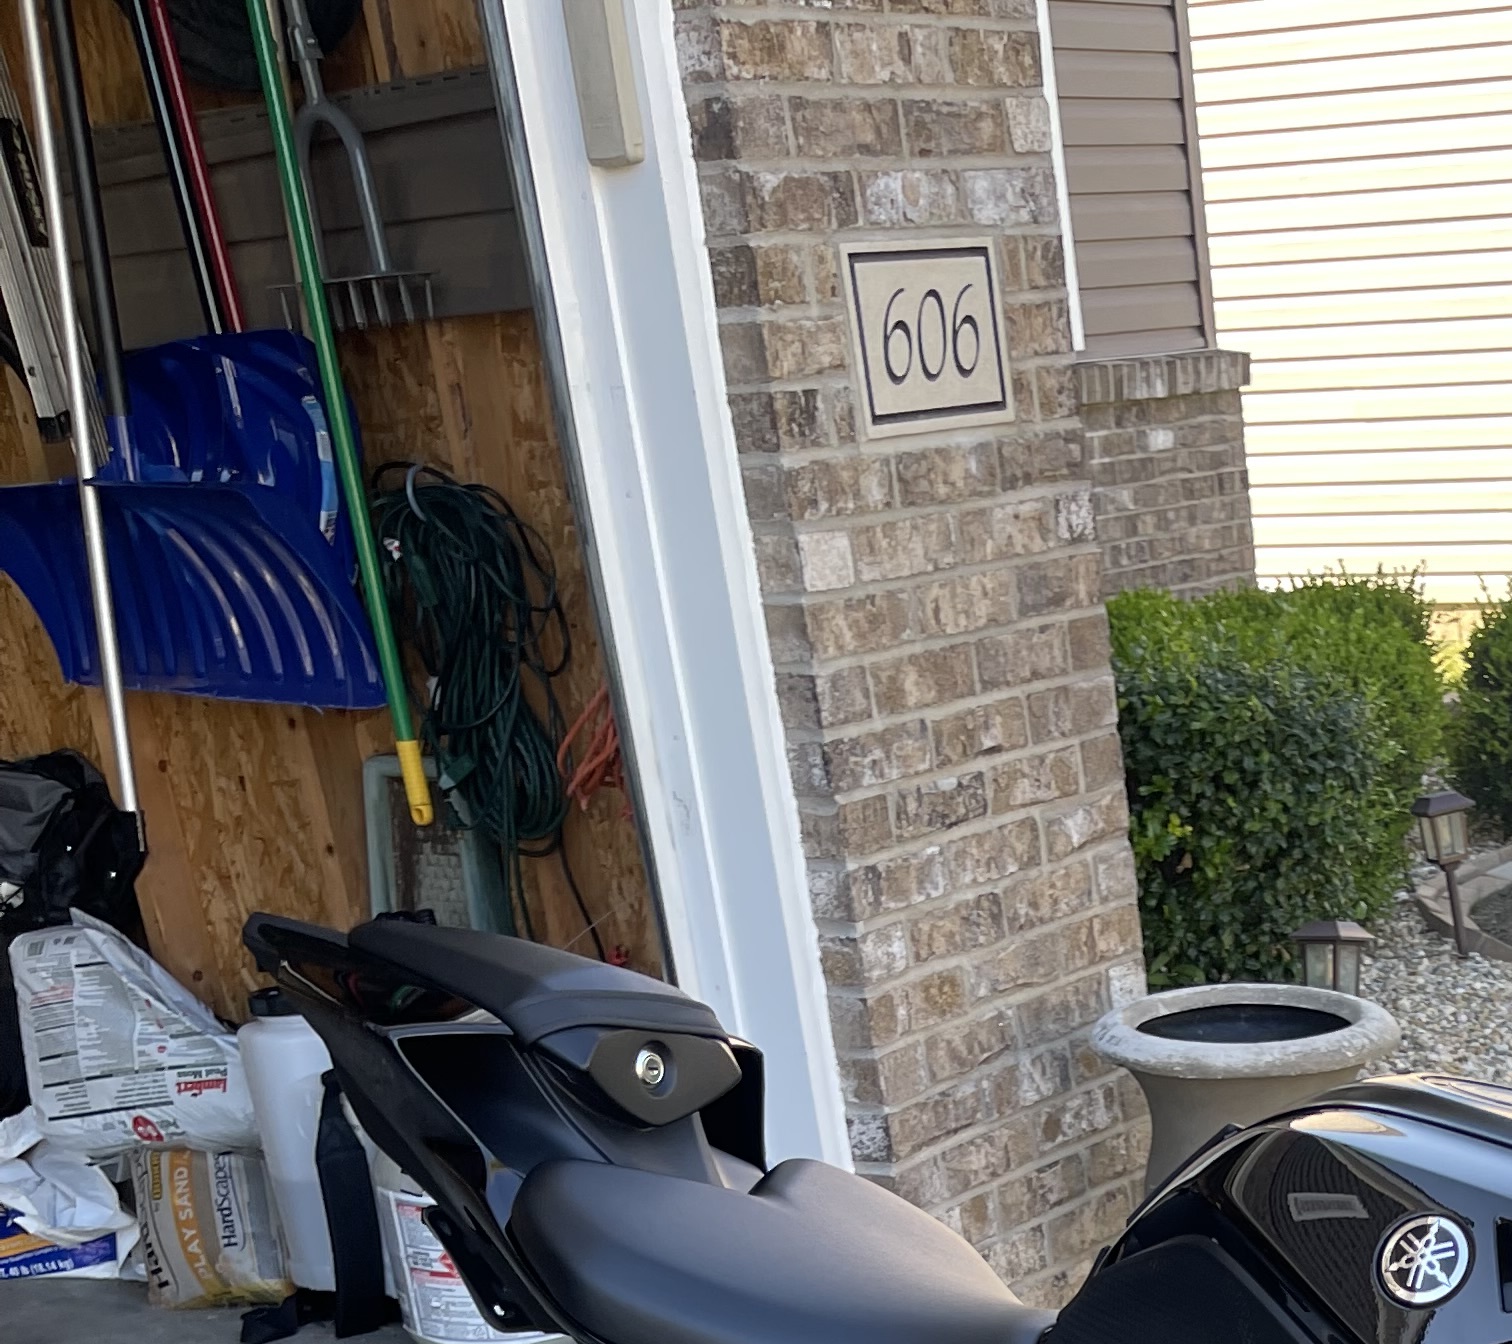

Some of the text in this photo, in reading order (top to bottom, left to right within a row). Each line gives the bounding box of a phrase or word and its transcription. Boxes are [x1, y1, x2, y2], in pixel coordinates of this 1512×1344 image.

[883, 284, 979, 386] 606
[173, 1166, 213, 1281] PLAY SAND
